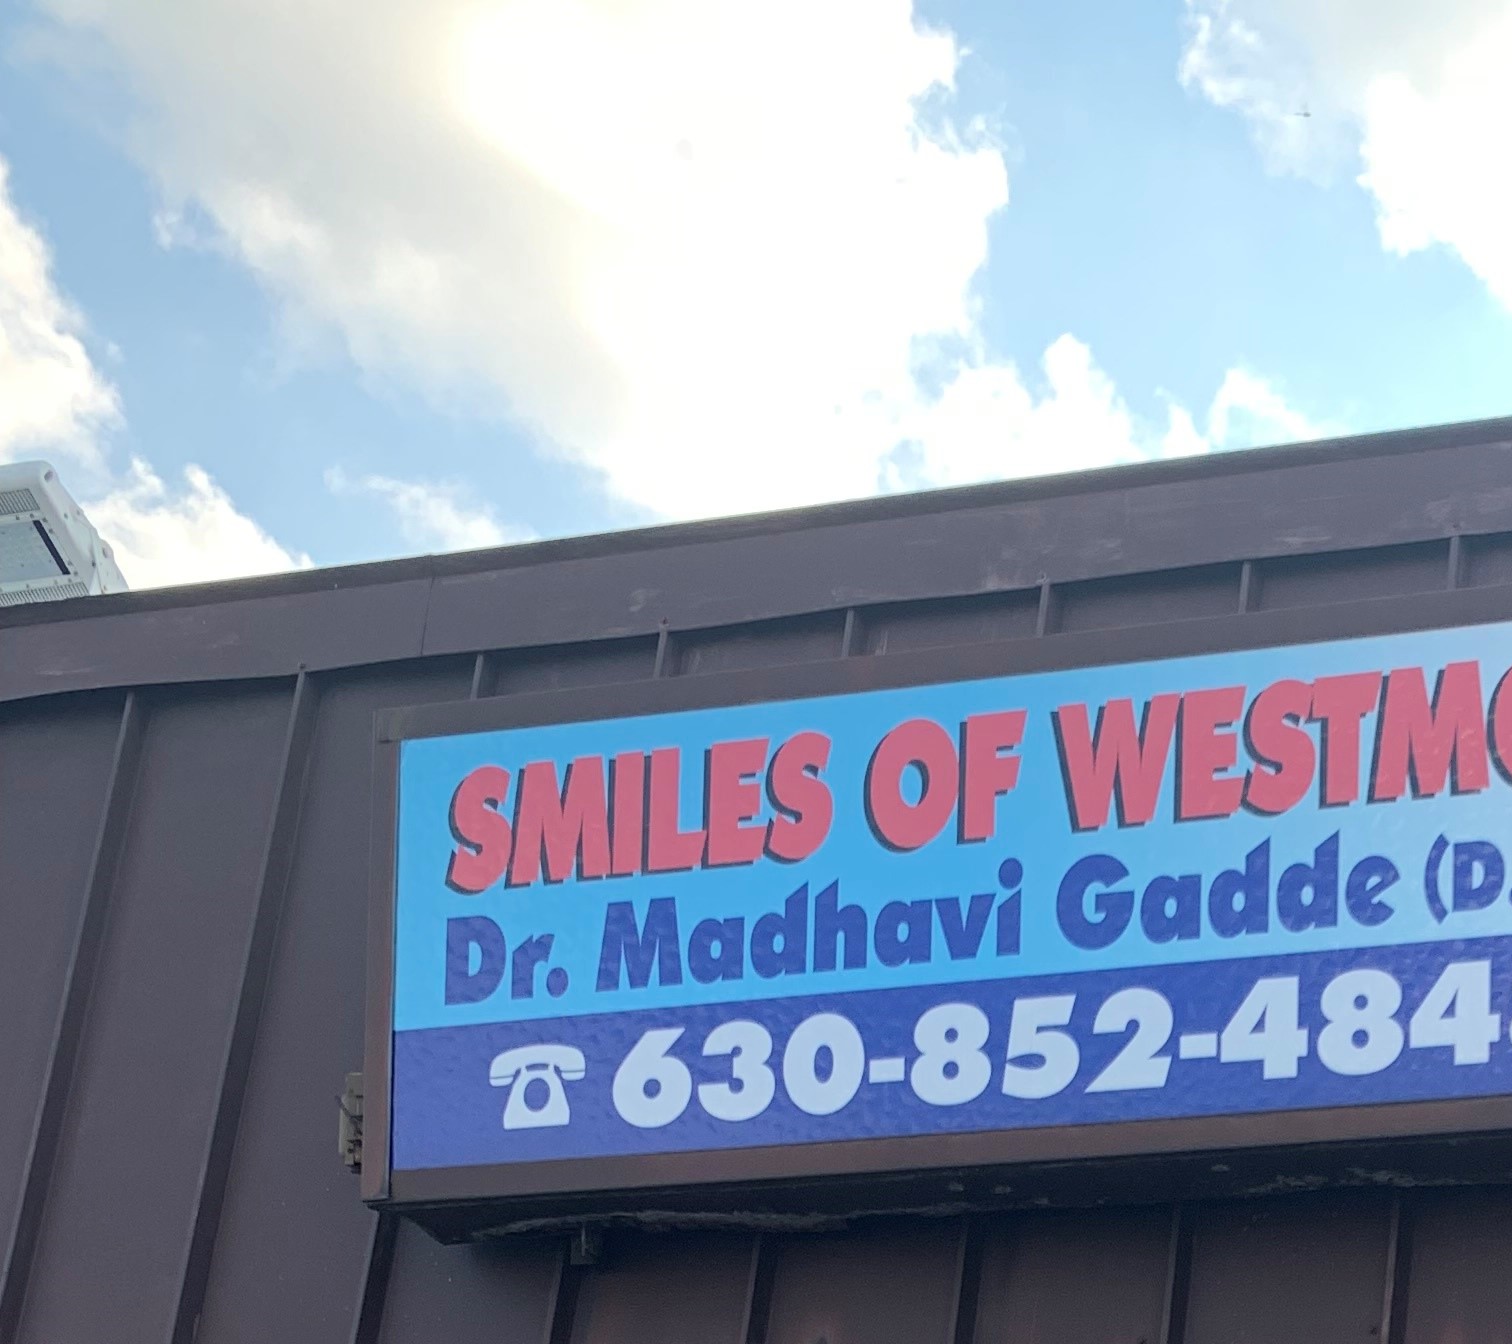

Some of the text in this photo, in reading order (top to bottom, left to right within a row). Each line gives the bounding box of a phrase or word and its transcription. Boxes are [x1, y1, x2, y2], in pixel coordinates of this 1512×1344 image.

[444, 730, 834, 895] SMILES
[864, 708, 1028, 855] OF
[444, 914, 569, 1006] Dr.
[595, 857, 1024, 992] Madhavi
[1056, 829, 1401, 951] Gadde
